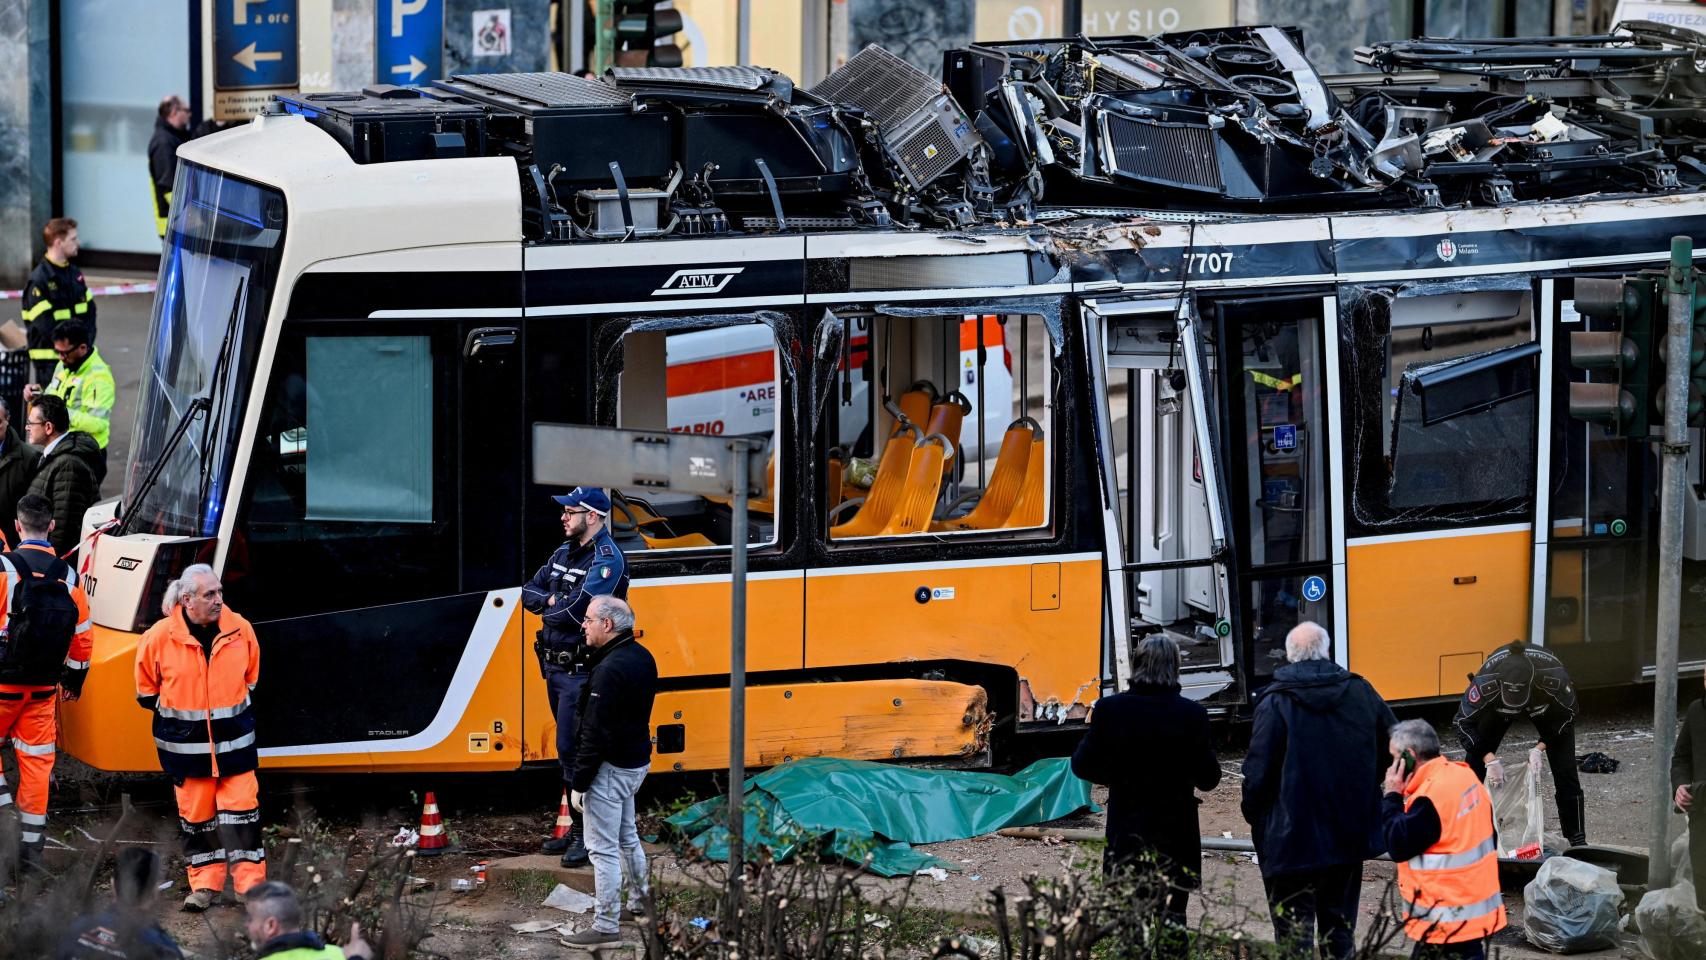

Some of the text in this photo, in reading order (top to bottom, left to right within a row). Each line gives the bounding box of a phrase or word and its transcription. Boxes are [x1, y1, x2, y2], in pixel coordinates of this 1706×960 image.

[255, 13, 289, 25] a ore
[391, 0, 428, 37] P
[1183, 252, 1233, 274] 7707
[679, 274, 715, 288] ATM
[494, 721, 503, 734] B
